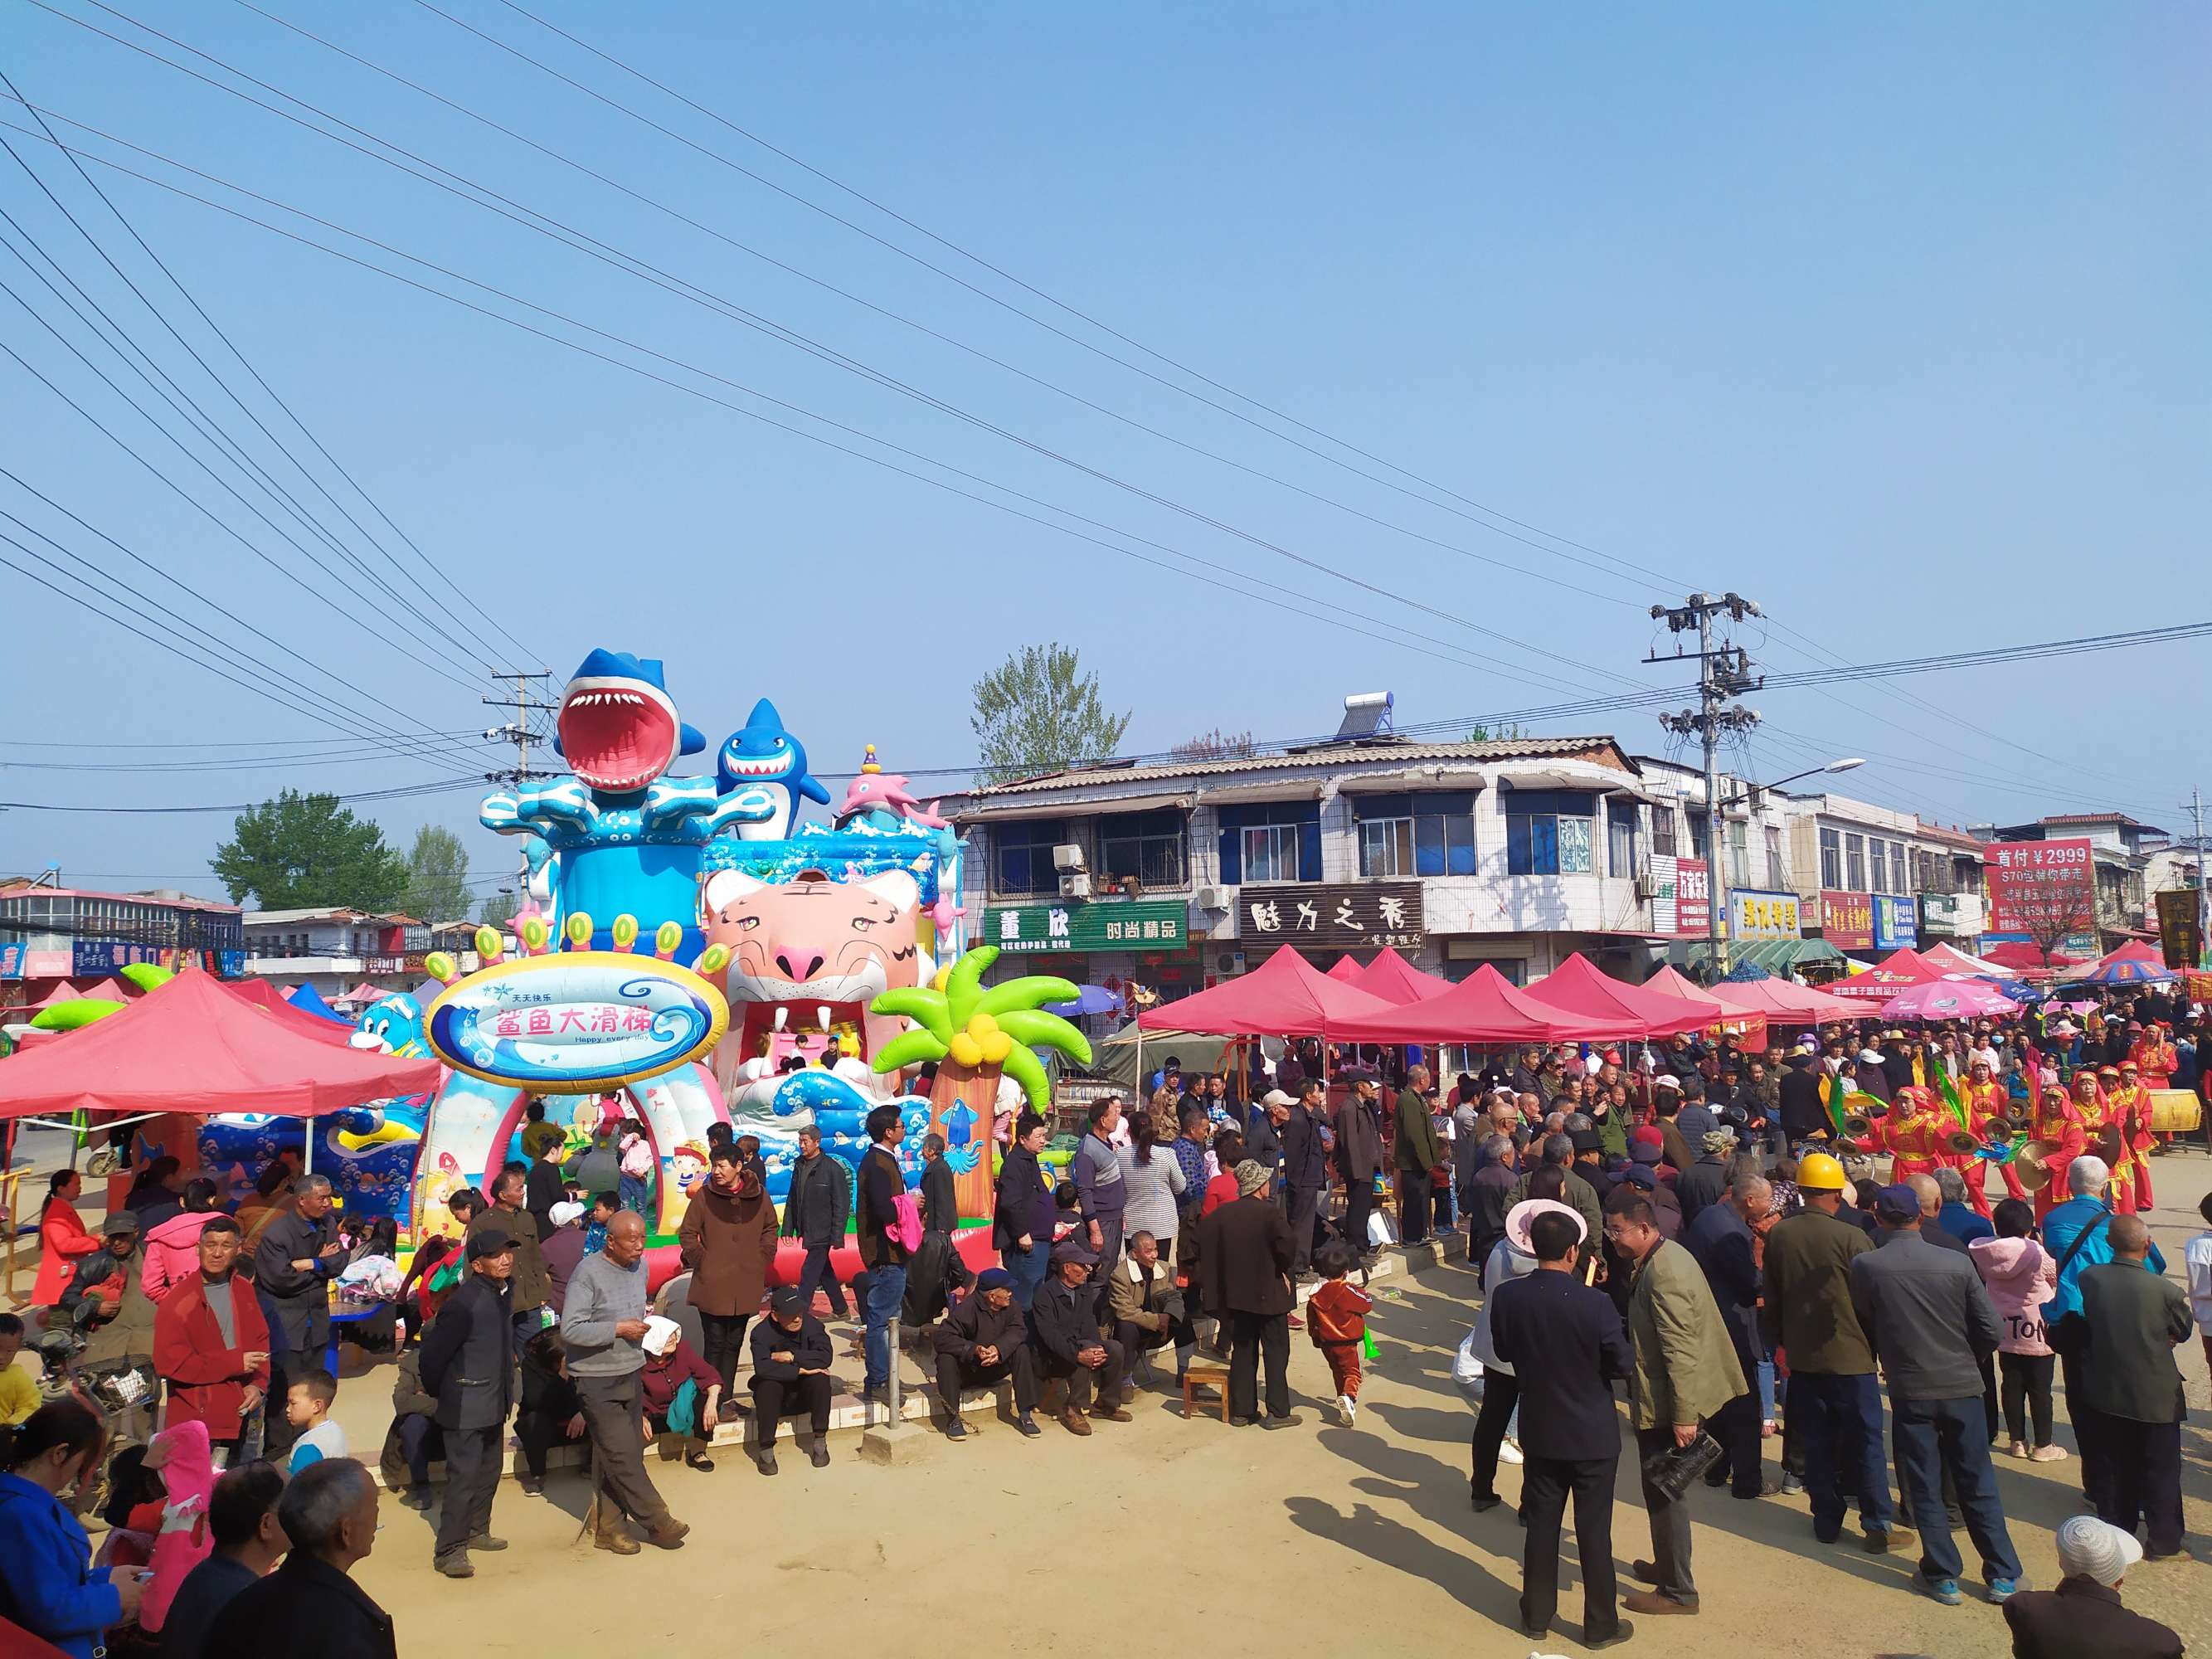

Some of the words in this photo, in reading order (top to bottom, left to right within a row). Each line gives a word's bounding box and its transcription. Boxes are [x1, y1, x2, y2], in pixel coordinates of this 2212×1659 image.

[1250, 898, 1407, 932] 魅力之秀
[1106, 921, 1176, 940] 时尚精品
[512, 993, 552, 1003] 天天快乐
[495, 1005, 652, 1037] 鲨鱼大滑梯
[575, 1036, 602, 1044] Happy
[605, 1035, 631, 1044] every
[2003, 1316, 2049, 1343] TON
